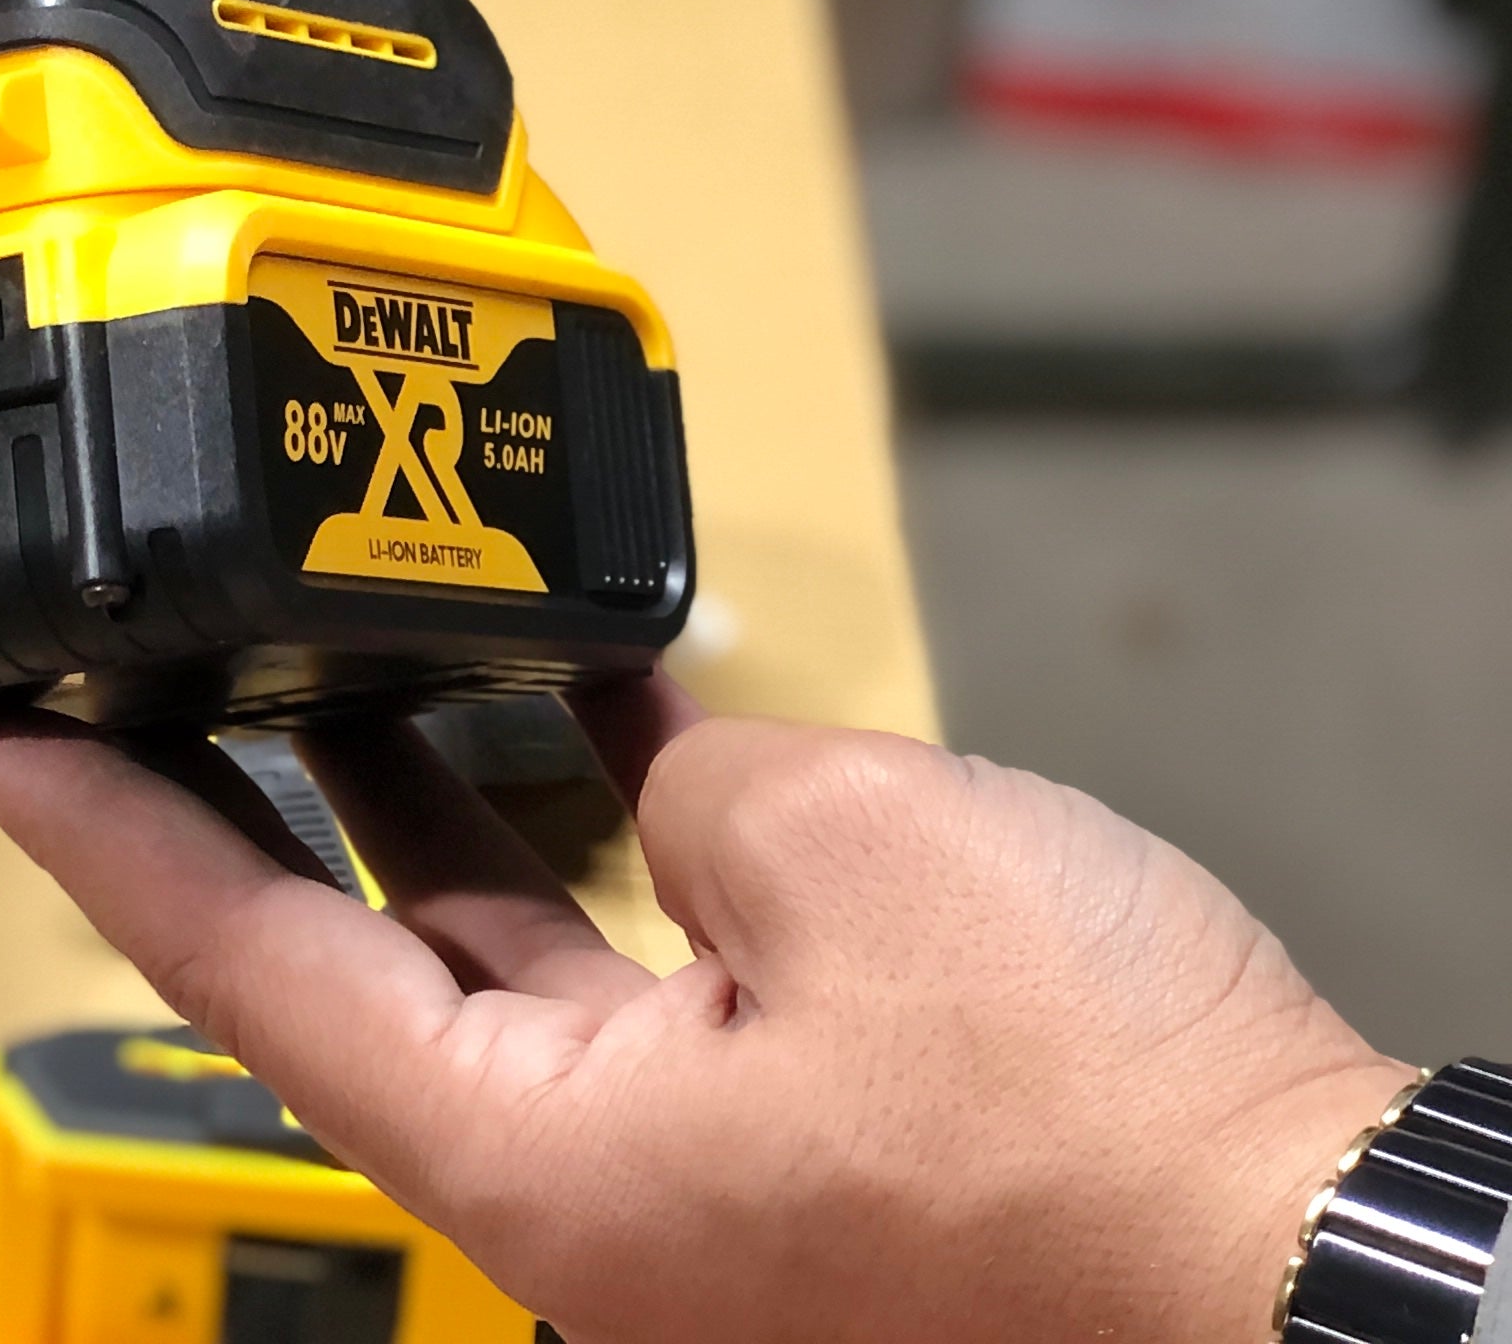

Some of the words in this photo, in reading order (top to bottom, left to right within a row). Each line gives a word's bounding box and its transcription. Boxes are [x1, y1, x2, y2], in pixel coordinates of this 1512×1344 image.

[333, 290, 474, 361] DEWALT
[333, 402, 365, 425] MAX
[480, 407, 552, 441] LI-ION
[483, 442, 545, 475] 5.0AH
[368, 538, 417, 564] LI-ION
[420, 542, 483, 570] BATTERY
